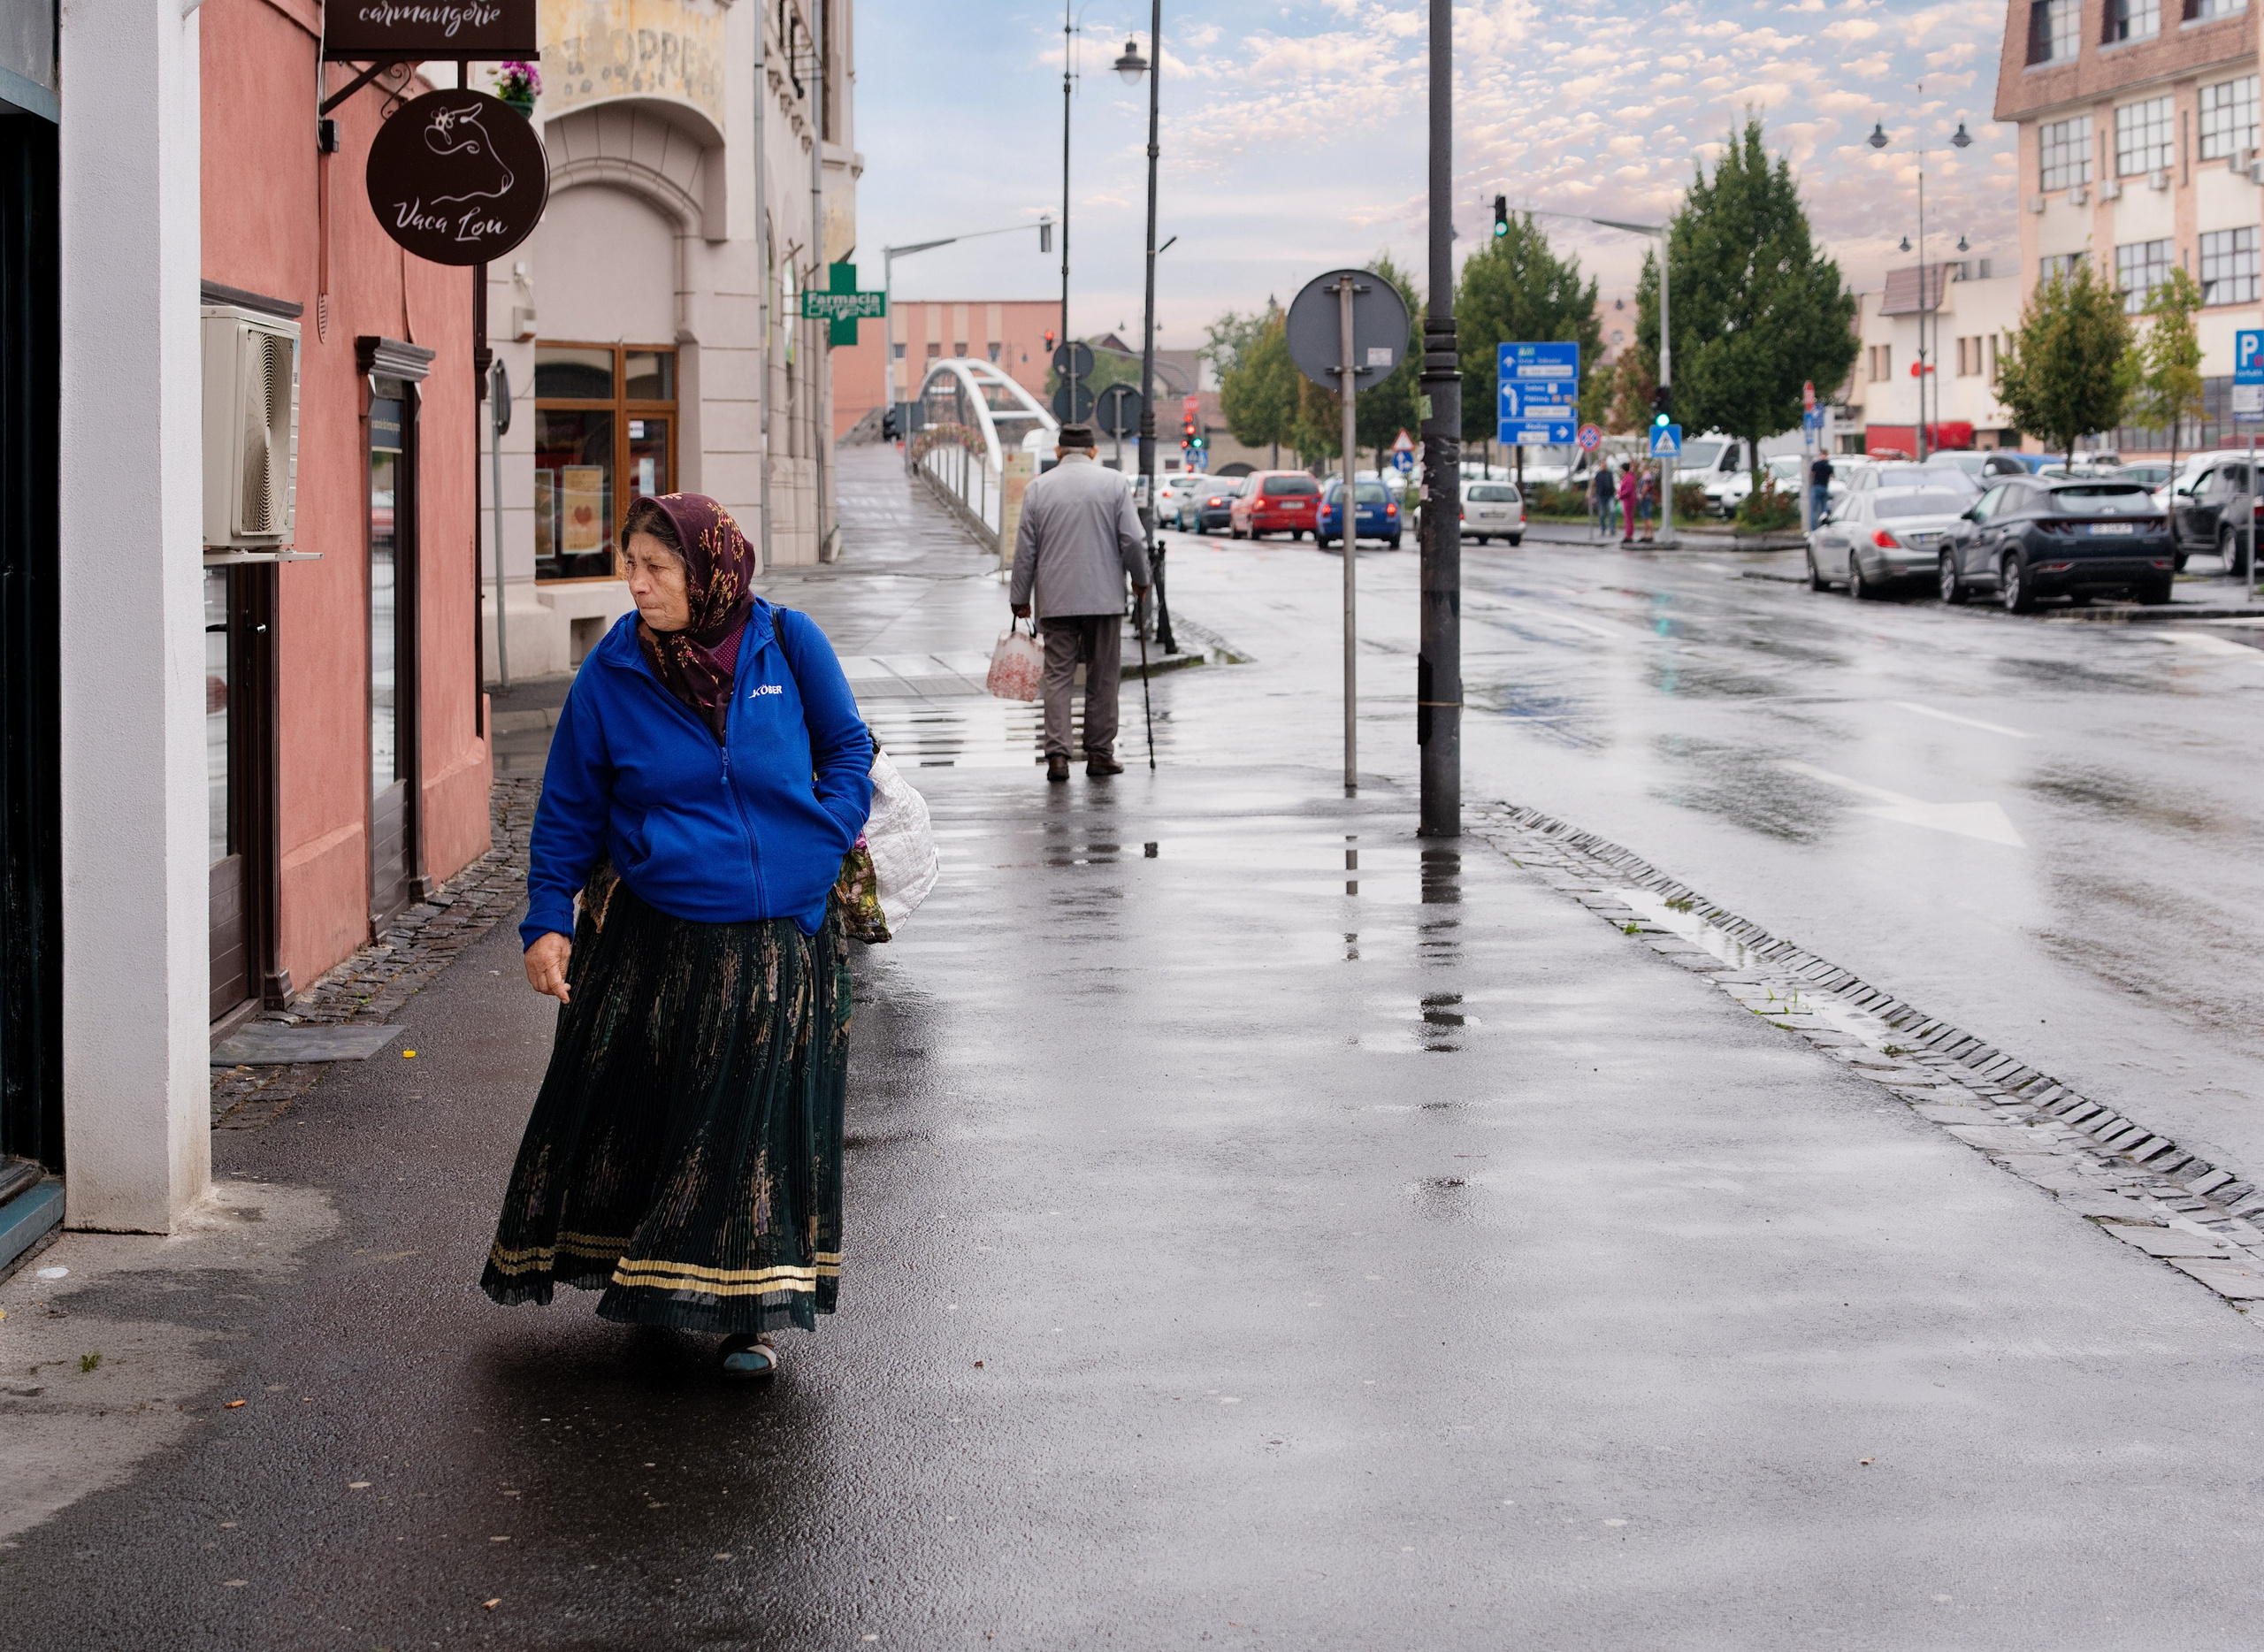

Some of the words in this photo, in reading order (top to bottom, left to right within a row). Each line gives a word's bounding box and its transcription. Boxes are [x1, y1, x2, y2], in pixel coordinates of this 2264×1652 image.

[358, 0, 501, 38] carmangerie
[393, 196, 447, 233] Vaca
[807, 292, 881, 305] Farmacia
[2240, 333, 2260, 368] P
